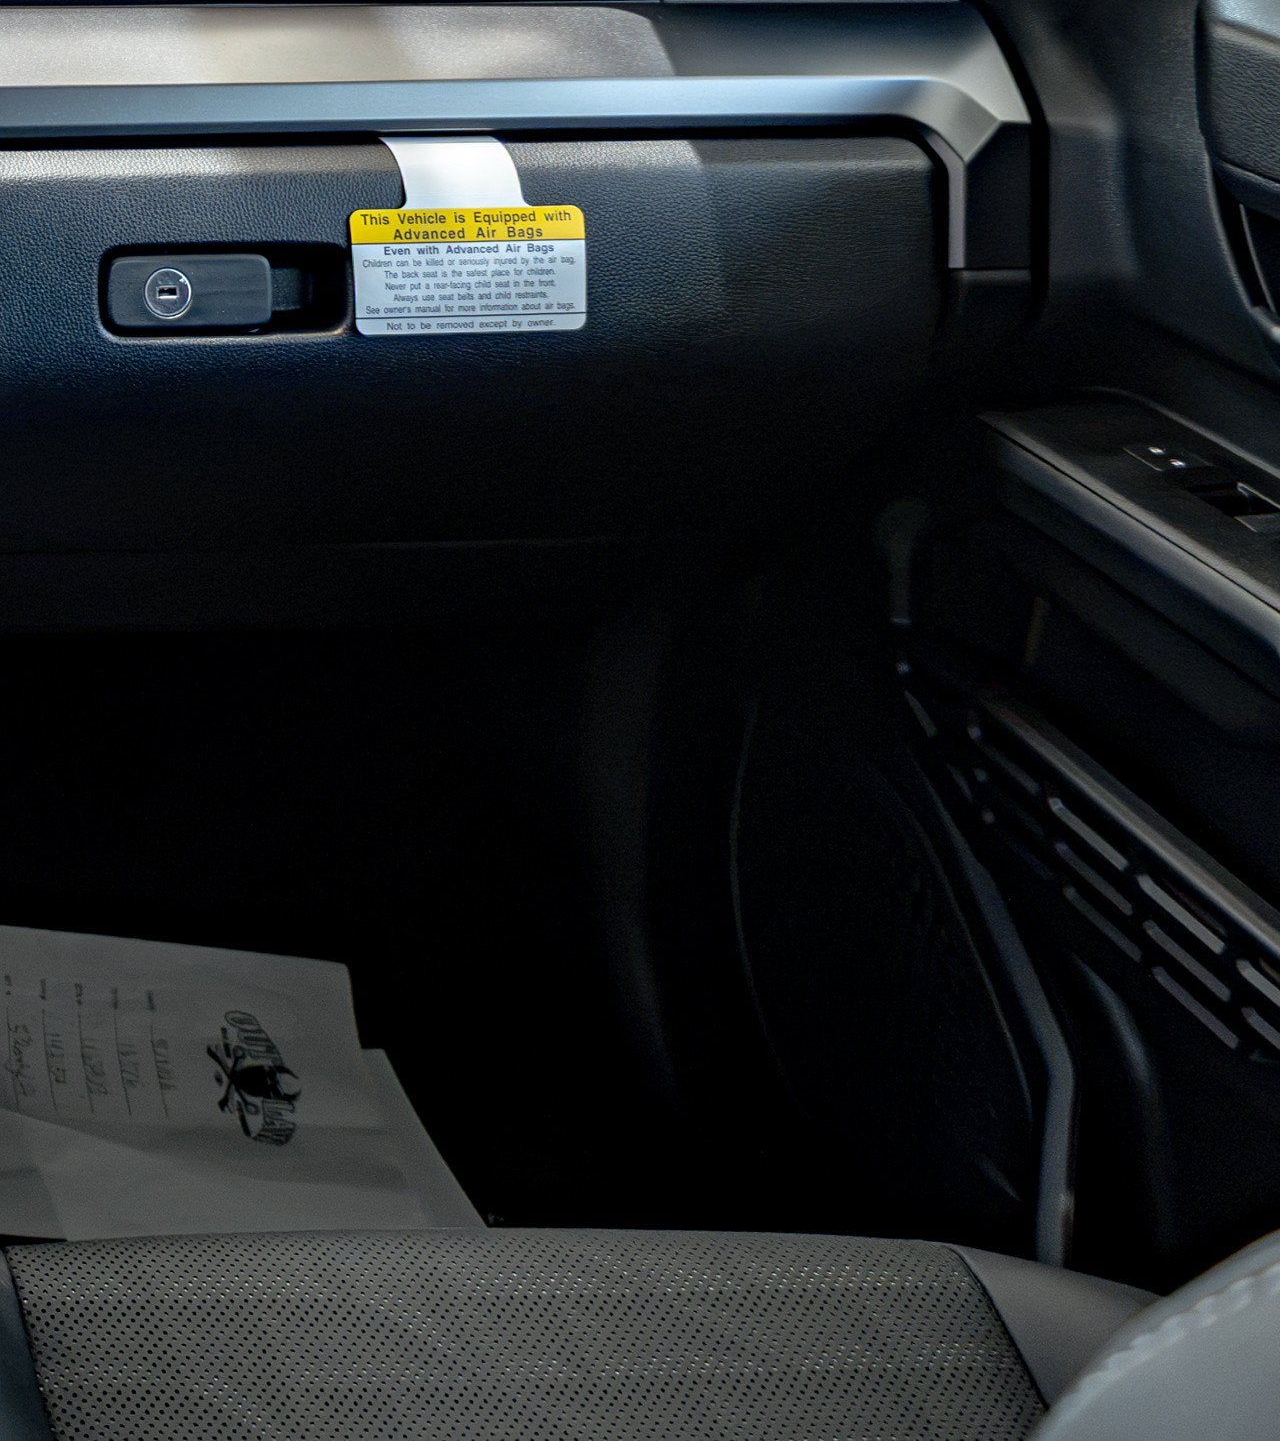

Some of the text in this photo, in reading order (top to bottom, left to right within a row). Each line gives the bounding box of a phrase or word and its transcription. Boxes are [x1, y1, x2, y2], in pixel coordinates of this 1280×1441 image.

[361, 211, 571, 226] This Vehicle is Equipped with
[393, 226, 543, 241] Advanced Air Bags
[384, 243, 554, 256] Even with Advanced Air Bags
[387, 319, 555, 331] Not to be removed except by owner.
